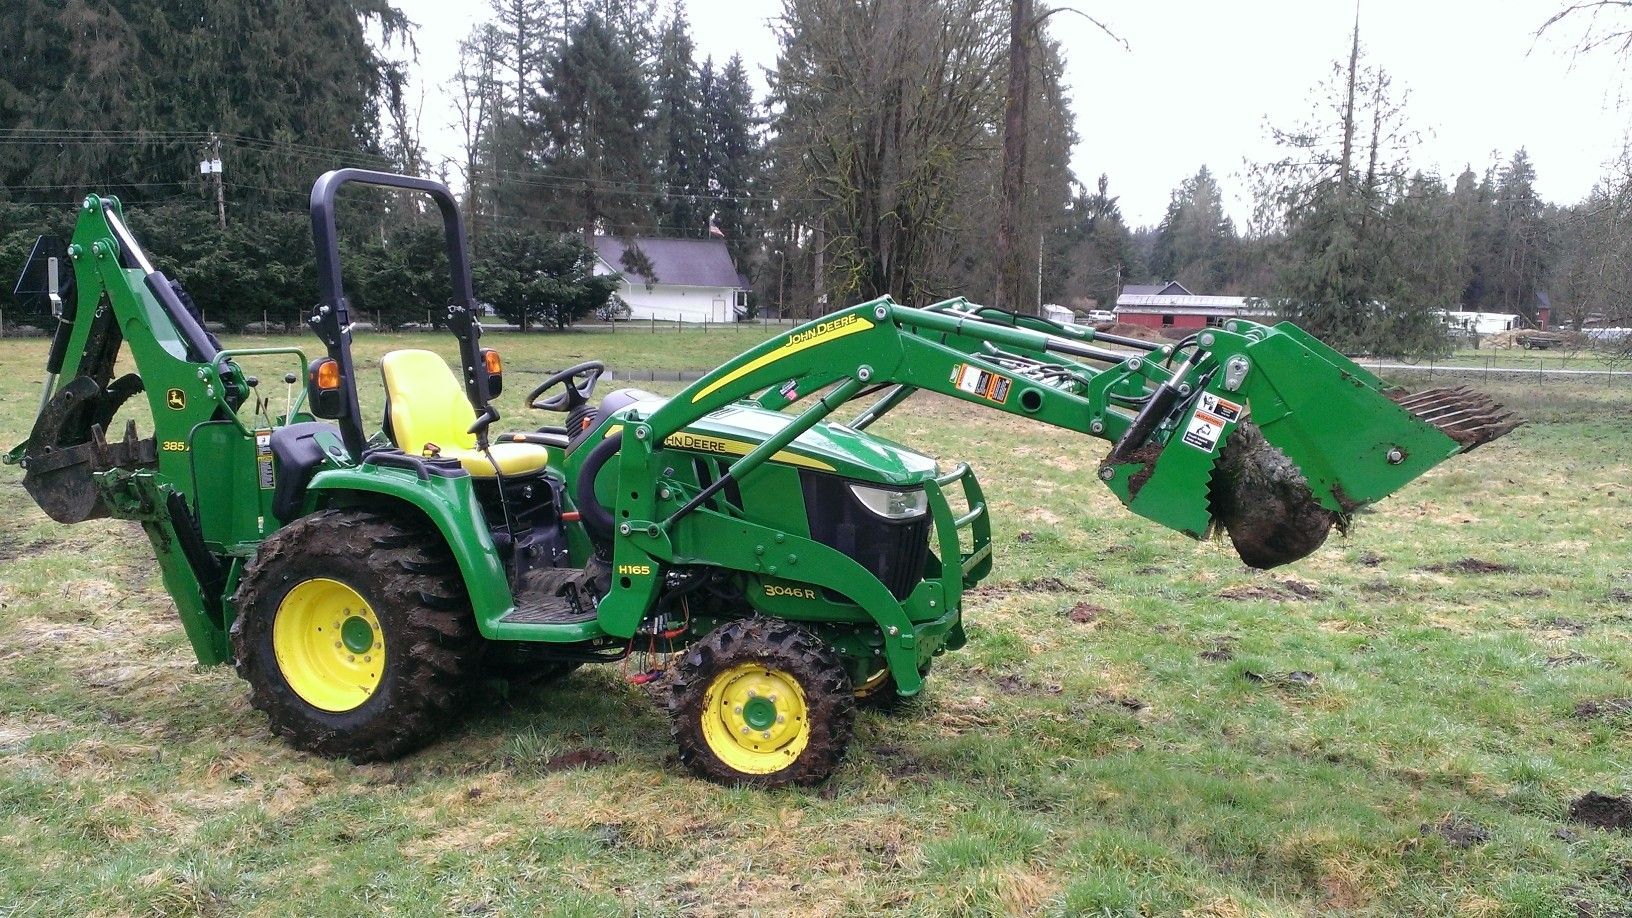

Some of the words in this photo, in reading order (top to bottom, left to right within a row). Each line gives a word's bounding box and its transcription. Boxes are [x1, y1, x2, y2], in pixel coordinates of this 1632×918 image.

[786, 328, 816, 347] JOHN
[816, 313, 857, 335] DEERE
[664, 435, 682, 446] HN
[684, 435, 726, 452] DEERE
[619, 564, 650, 575] H165
